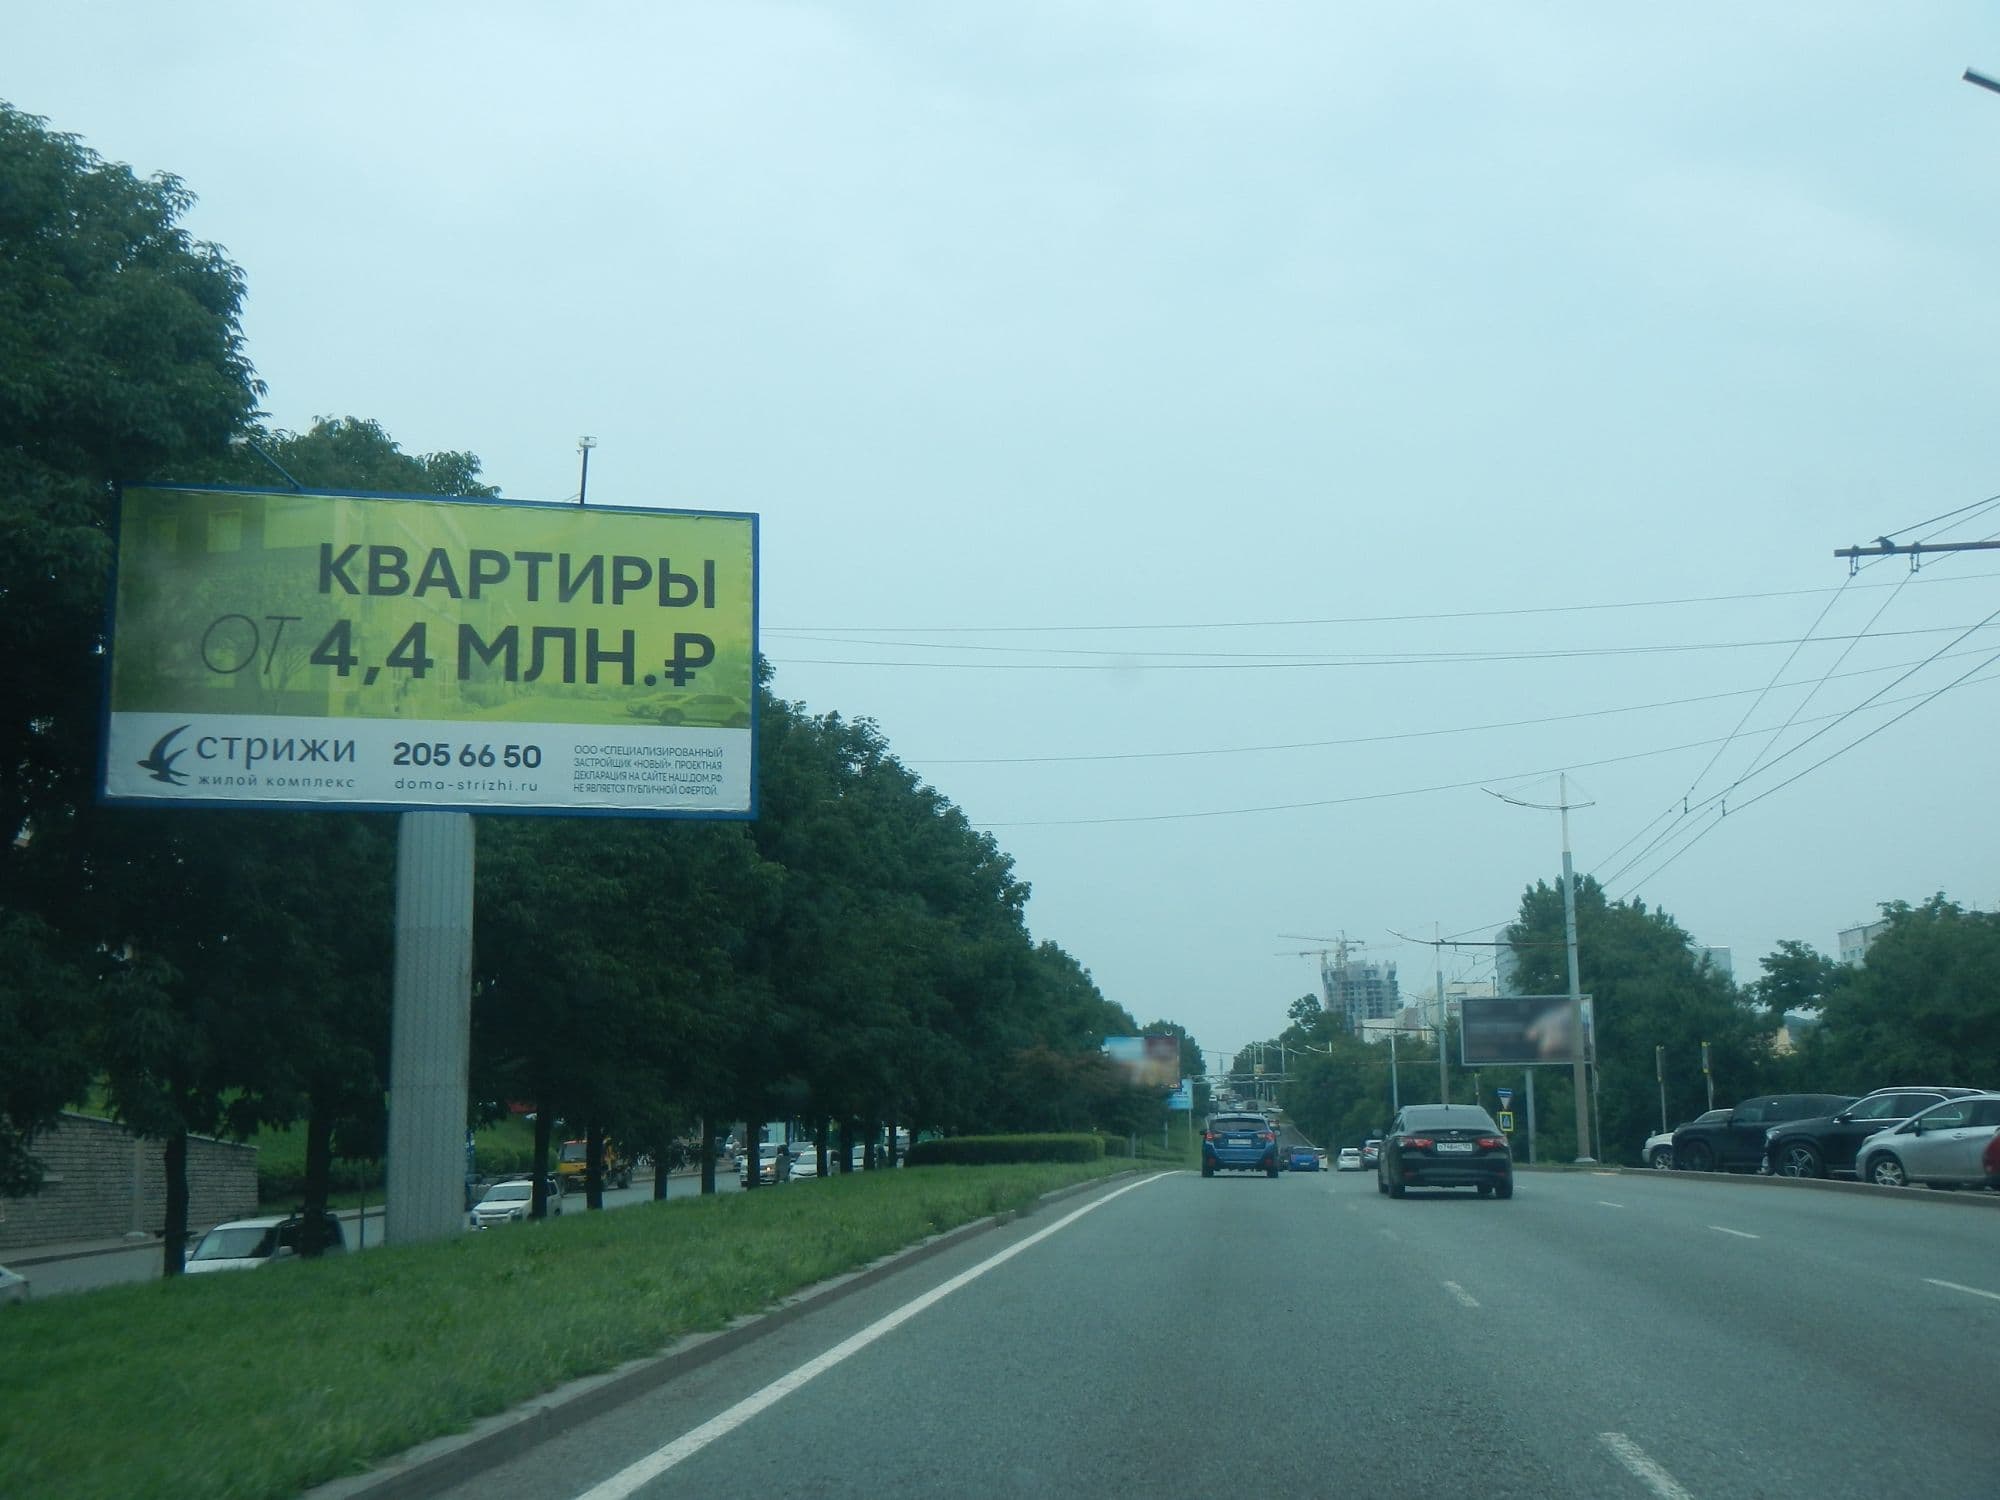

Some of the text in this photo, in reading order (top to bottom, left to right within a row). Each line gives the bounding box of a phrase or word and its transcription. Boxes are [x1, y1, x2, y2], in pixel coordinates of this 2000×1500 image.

[318, 542, 715, 609] КВАРТИРЫ
[200, 612, 301, 675] ОТ
[309, 618, 434, 686] 4,4
[196, 735, 356, 770] стрижи
[392, 742, 542, 769] 205 66 50
[574, 745, 598, 755] ООО
[574, 757, 633, 768] ЗАСТРОЙЩИК
[675, 760, 722, 770] ПРОЕКТНАЯ
[198, 774, 356, 789] жилой комплекс
[573, 770, 627, 782] ДЕКЛАРАЦИЯ
[629, 772, 640, 781] НА
[642, 770, 667, 782] САЙТЕ
[394, 777, 539, 793] doma-strizhi.ru
[573, 783, 584, 792] НЕ
[586, 784, 625, 794] ЯВЛЯЕТСЯ
[626, 783, 677, 795] ПУБЛИЧНОЙ
